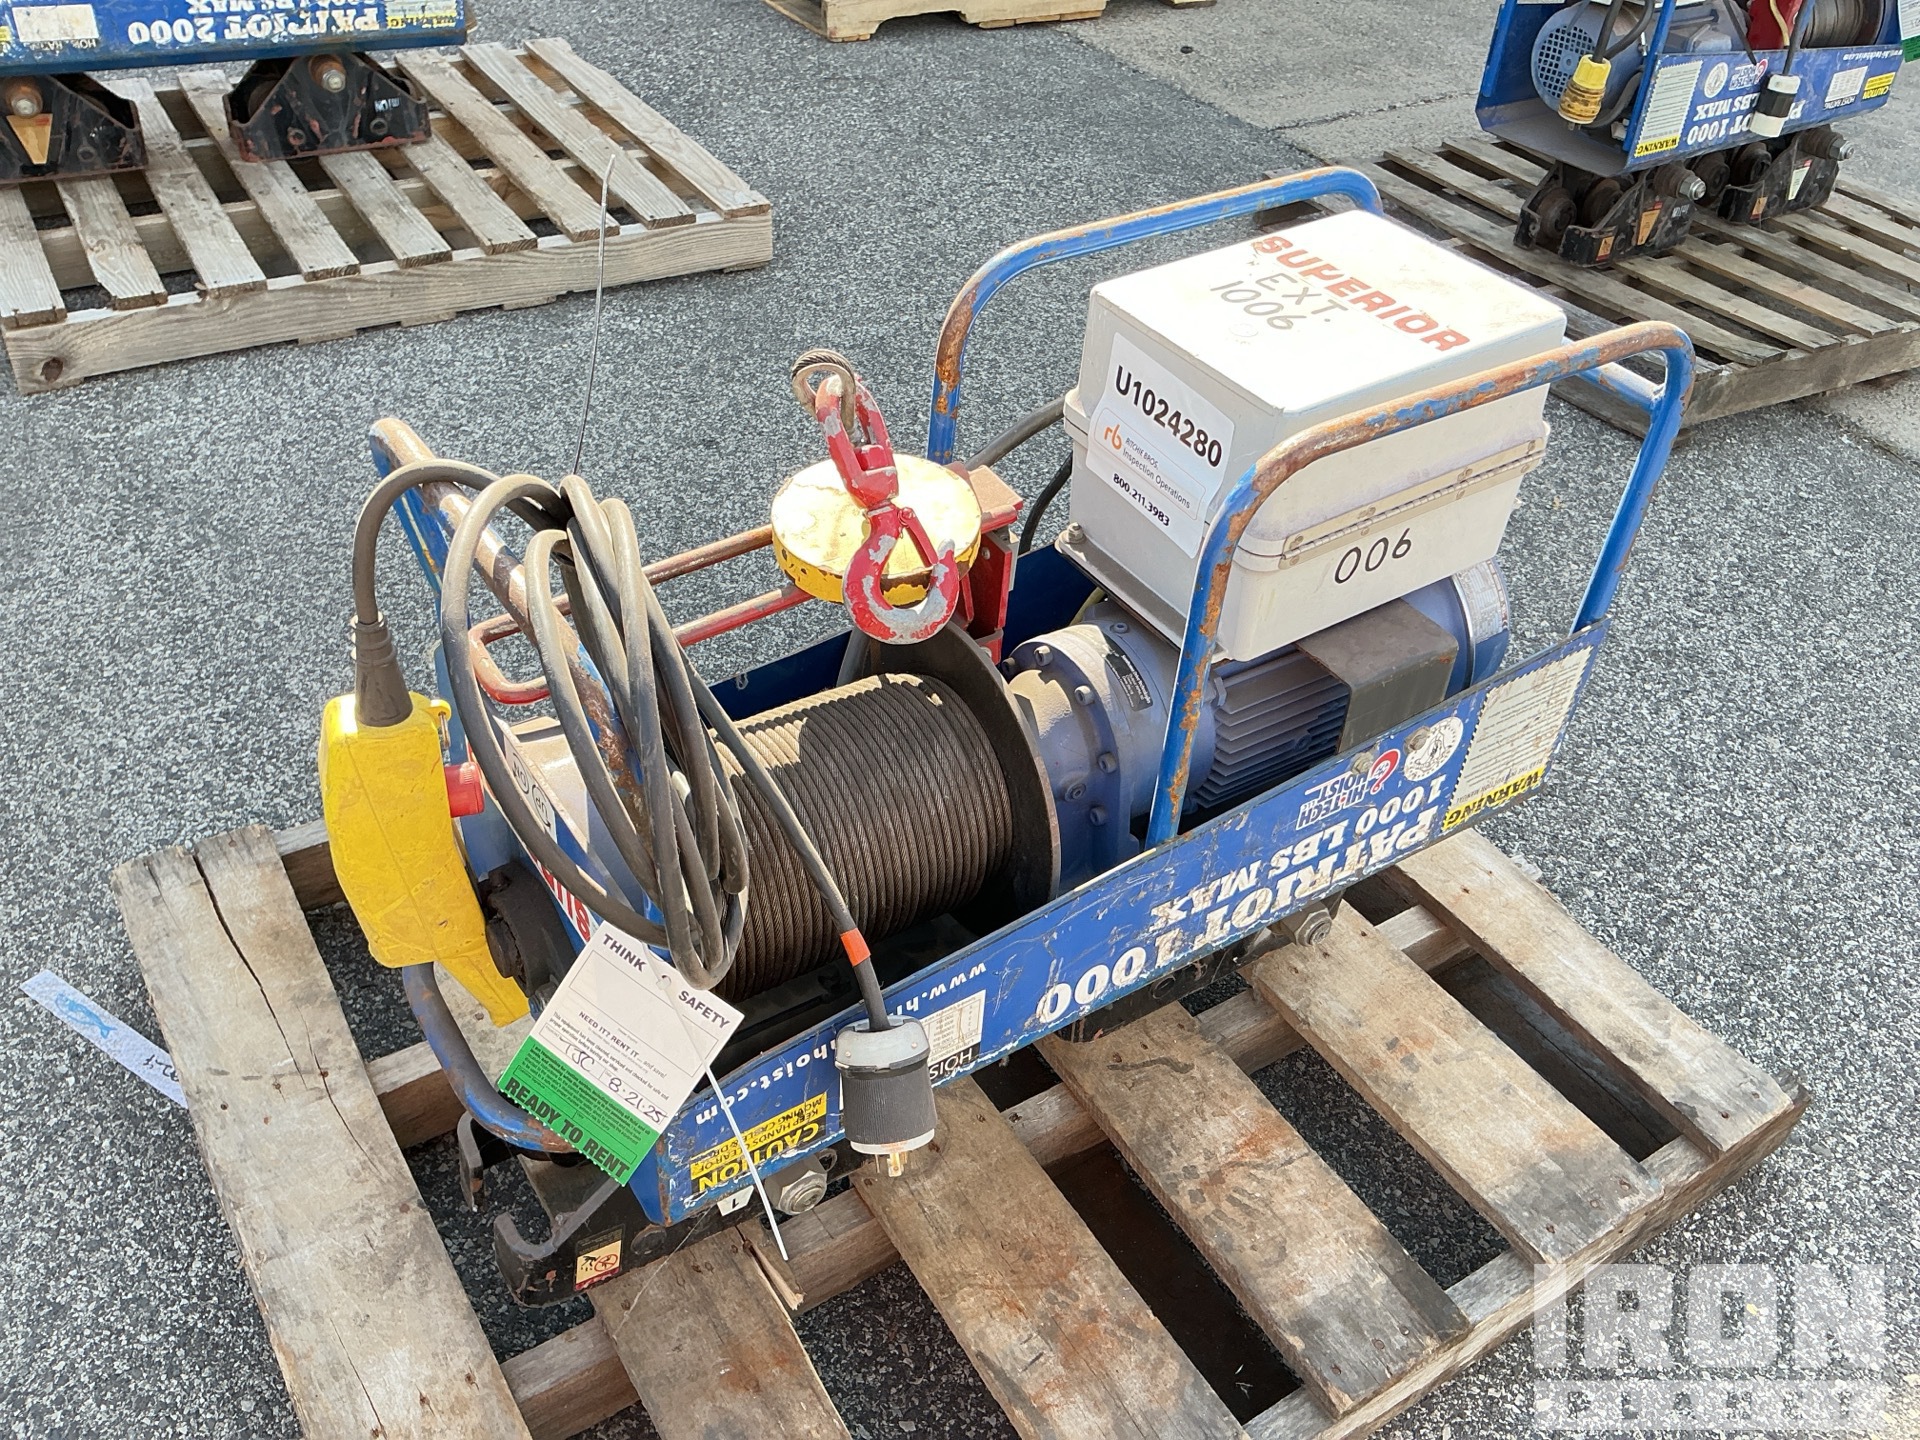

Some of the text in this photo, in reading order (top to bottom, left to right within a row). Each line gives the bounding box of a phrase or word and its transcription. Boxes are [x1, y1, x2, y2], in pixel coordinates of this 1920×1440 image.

[127, 16, 217, 44] 2000
[1687, 117, 1730, 146] 1000
[1692, 98, 1732, 122] MAX
[1636, 138, 1678, 155] WARNING
[1209, 279, 1308, 331] 1006
[1256, 236, 1471, 352] SUPERIOR
[1115, 365, 1223, 468] U1024280
[1125, 438, 1145, 458] RITCHIE
[1113, 473, 1171, 527] 800.211.3983
[1122, 447, 1191, 509] Inspection Operations
[1333, 527, 1414, 586] 006
[1446, 771, 1540, 828] WARNING
[1149, 774, 1448, 932] 1000 LBS MAX
[1035, 806, 1438, 1024] PATRIOT 1000
[600, 933, 730, 1030] THINK SAFETY
[578, 1011, 599, 1029] NEED
[598, 1026, 611, 1037] IT?
[610, 1035, 630, 1052] RENT
[929, 1047, 973, 1081] HOIS
[504, 1075, 561, 1128] READY
[557, 1117, 584, 1145] TO
[582, 1136, 630, 1181] RENT
[753, 1120, 793, 1145] HANDS
[792, 1107, 820, 1126] KEEP
[698, 1122, 820, 1193] CAUTION
